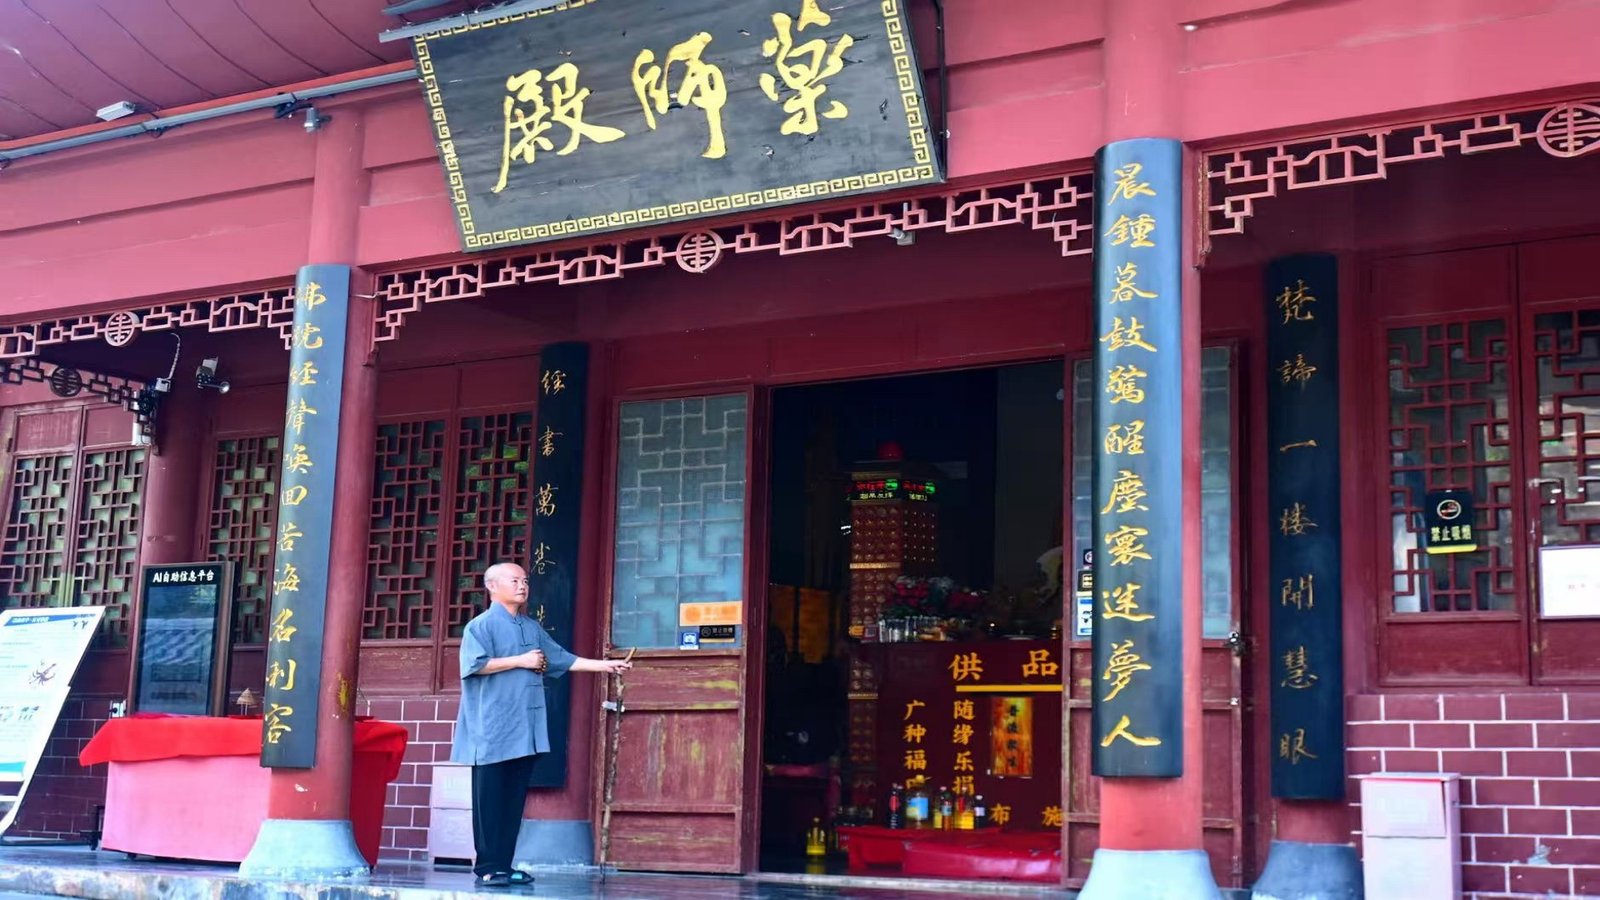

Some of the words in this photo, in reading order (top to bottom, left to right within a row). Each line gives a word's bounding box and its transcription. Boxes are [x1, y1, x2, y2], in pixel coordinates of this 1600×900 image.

[152, 569, 215, 583] AI自助信息平台
[949, 649, 1058, 681] 供品
